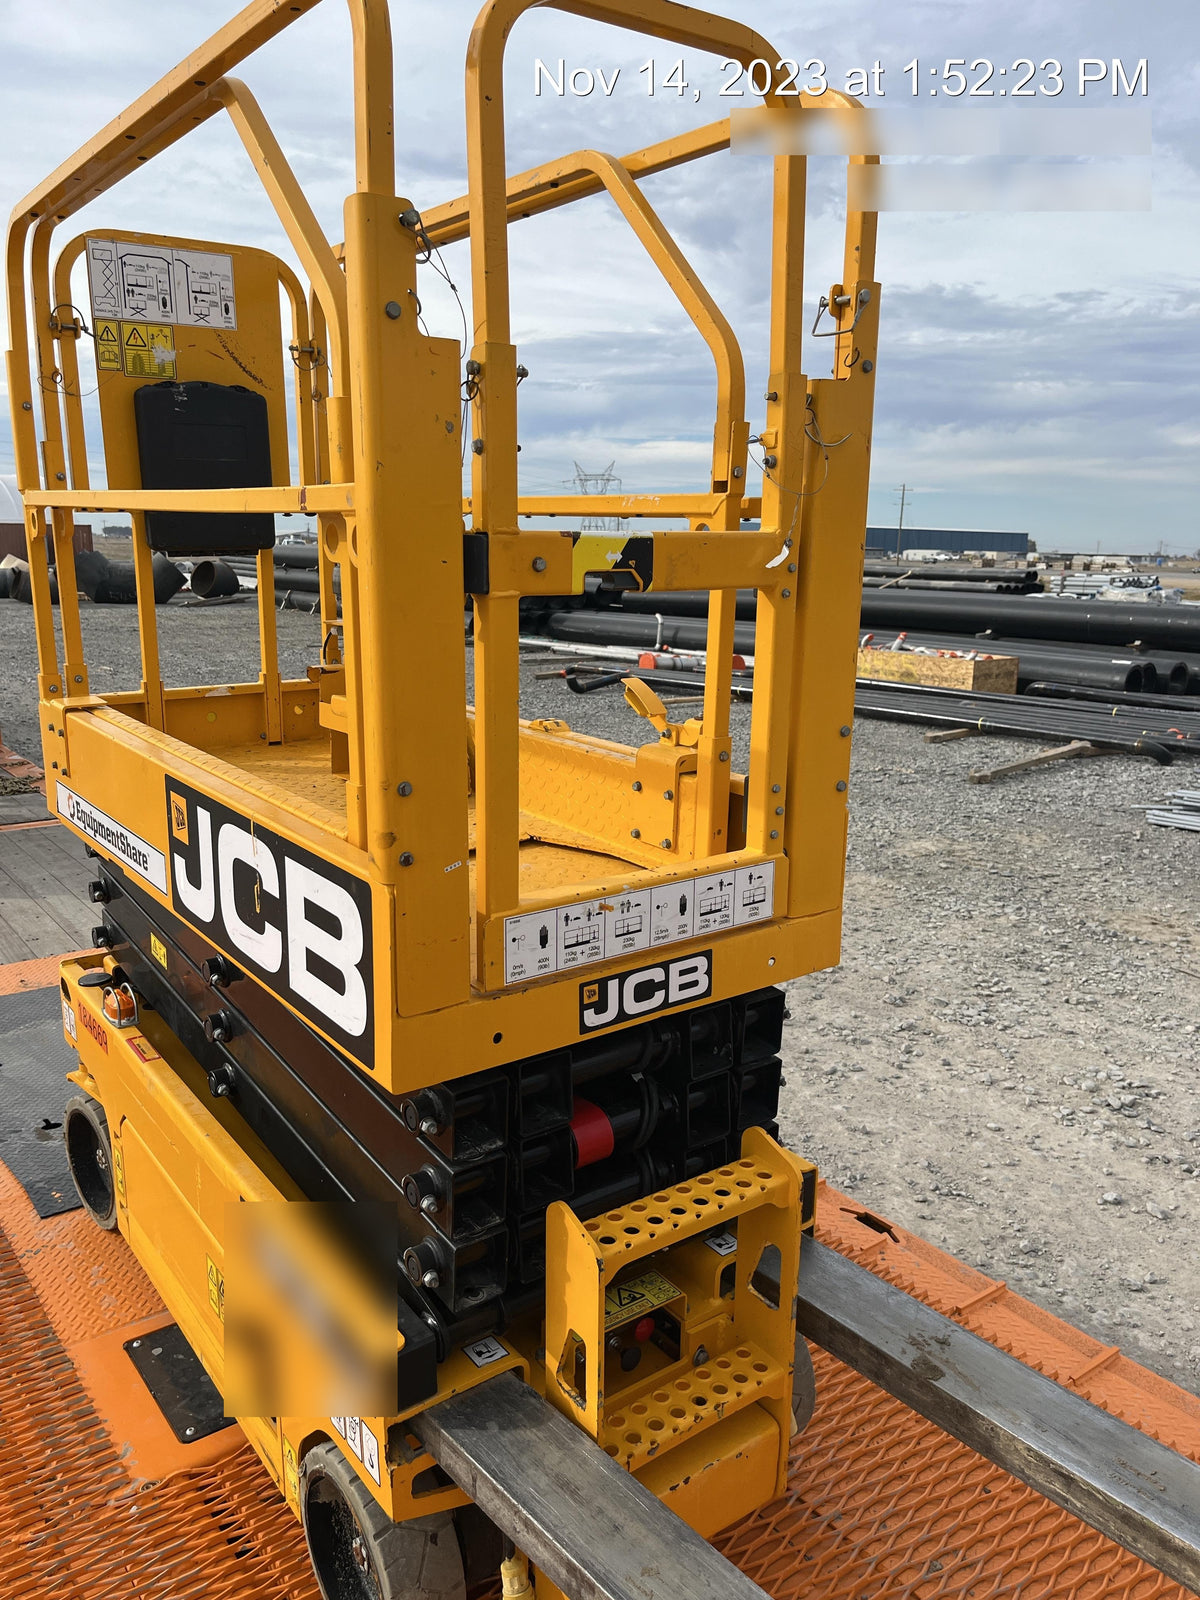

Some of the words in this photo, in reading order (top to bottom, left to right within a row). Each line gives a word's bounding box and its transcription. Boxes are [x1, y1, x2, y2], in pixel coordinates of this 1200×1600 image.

[75, 800, 149, 872] EquipmentShare
[174, 805, 367, 1037] JCB
[583, 956, 709, 1027] JCB
[78, 1002, 108, 1054] 184669
